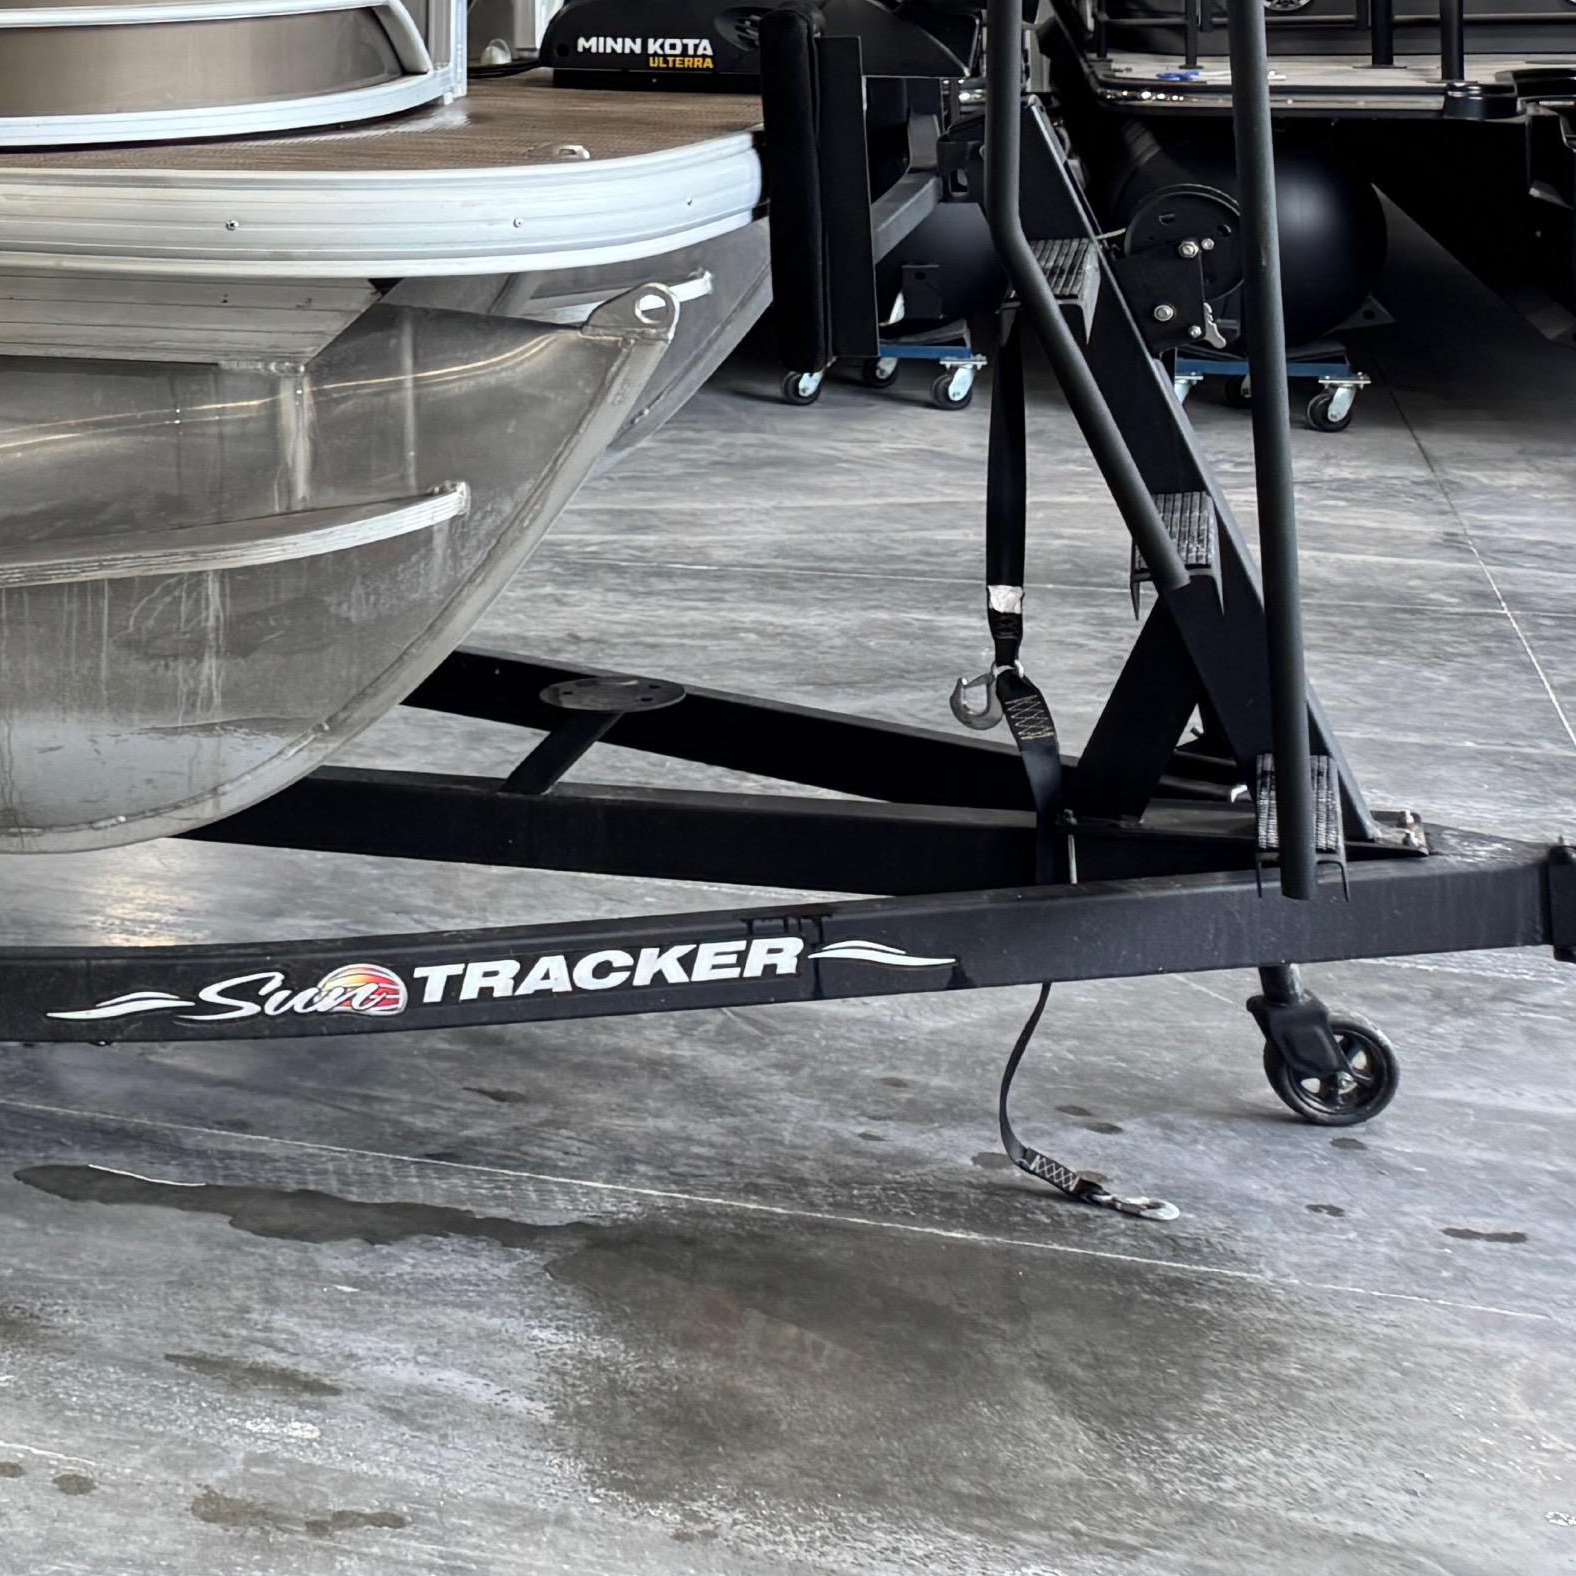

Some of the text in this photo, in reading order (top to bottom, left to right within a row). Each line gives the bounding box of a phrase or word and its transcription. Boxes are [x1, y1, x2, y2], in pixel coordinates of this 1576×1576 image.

[577, 36, 714, 56] MINN KOTA
[649, 56, 714, 69] ULTERRA
[175, 936, 805, 1021] Sun TRACKER
